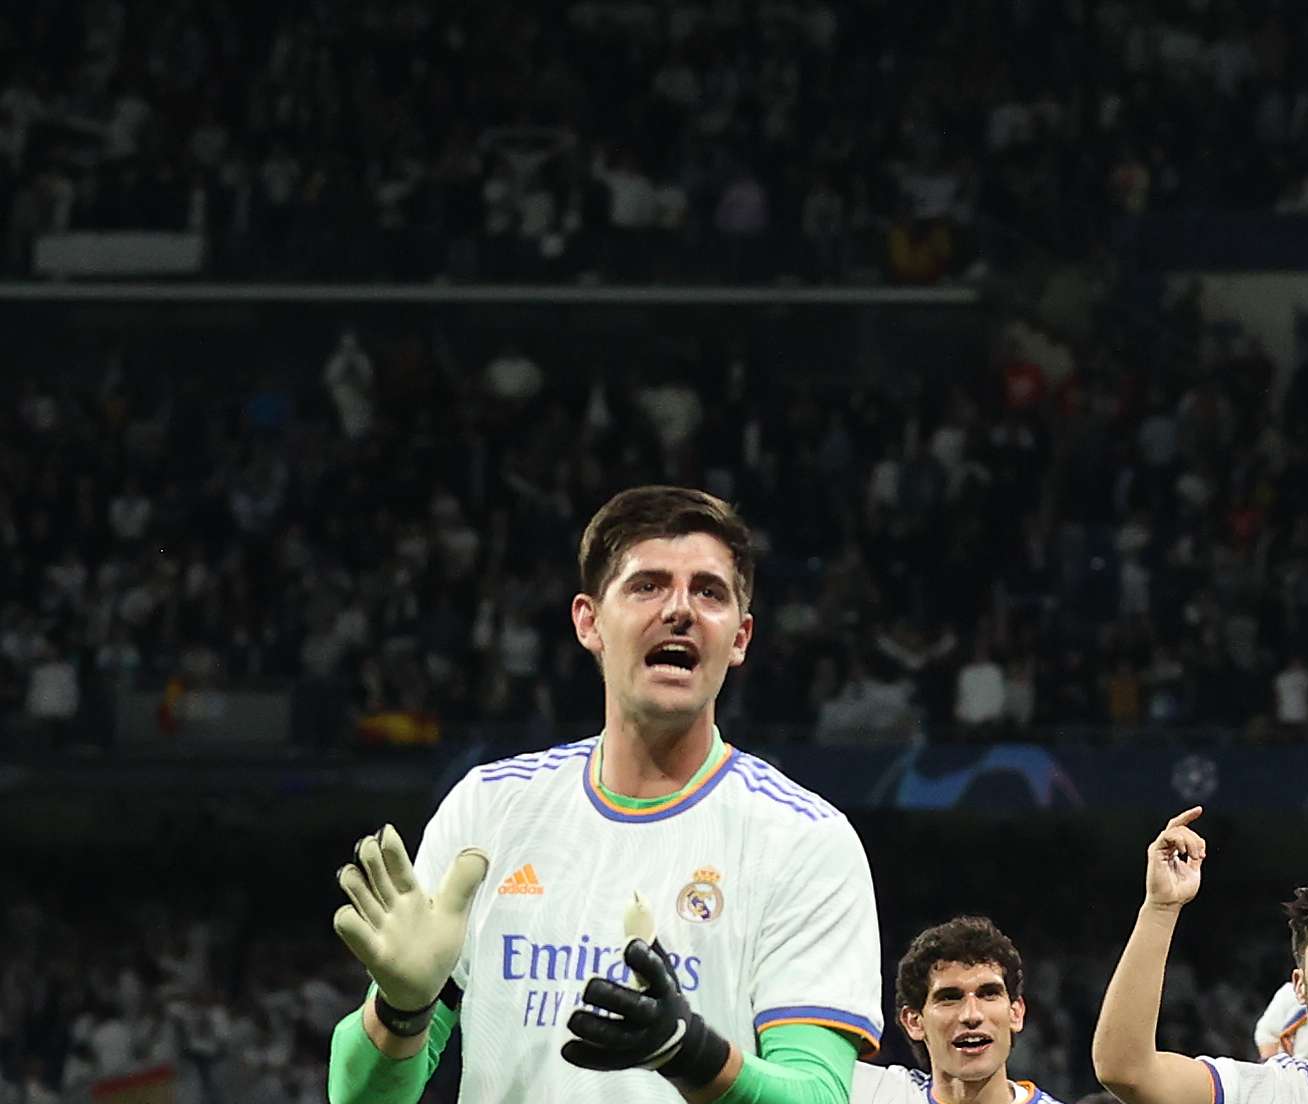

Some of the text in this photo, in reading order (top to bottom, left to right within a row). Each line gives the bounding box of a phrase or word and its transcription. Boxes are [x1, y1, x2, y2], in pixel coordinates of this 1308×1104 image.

[498, 885, 544, 895] adidas
[502, 934, 702, 991] Emiras
[523, 990, 564, 1027] FLY
